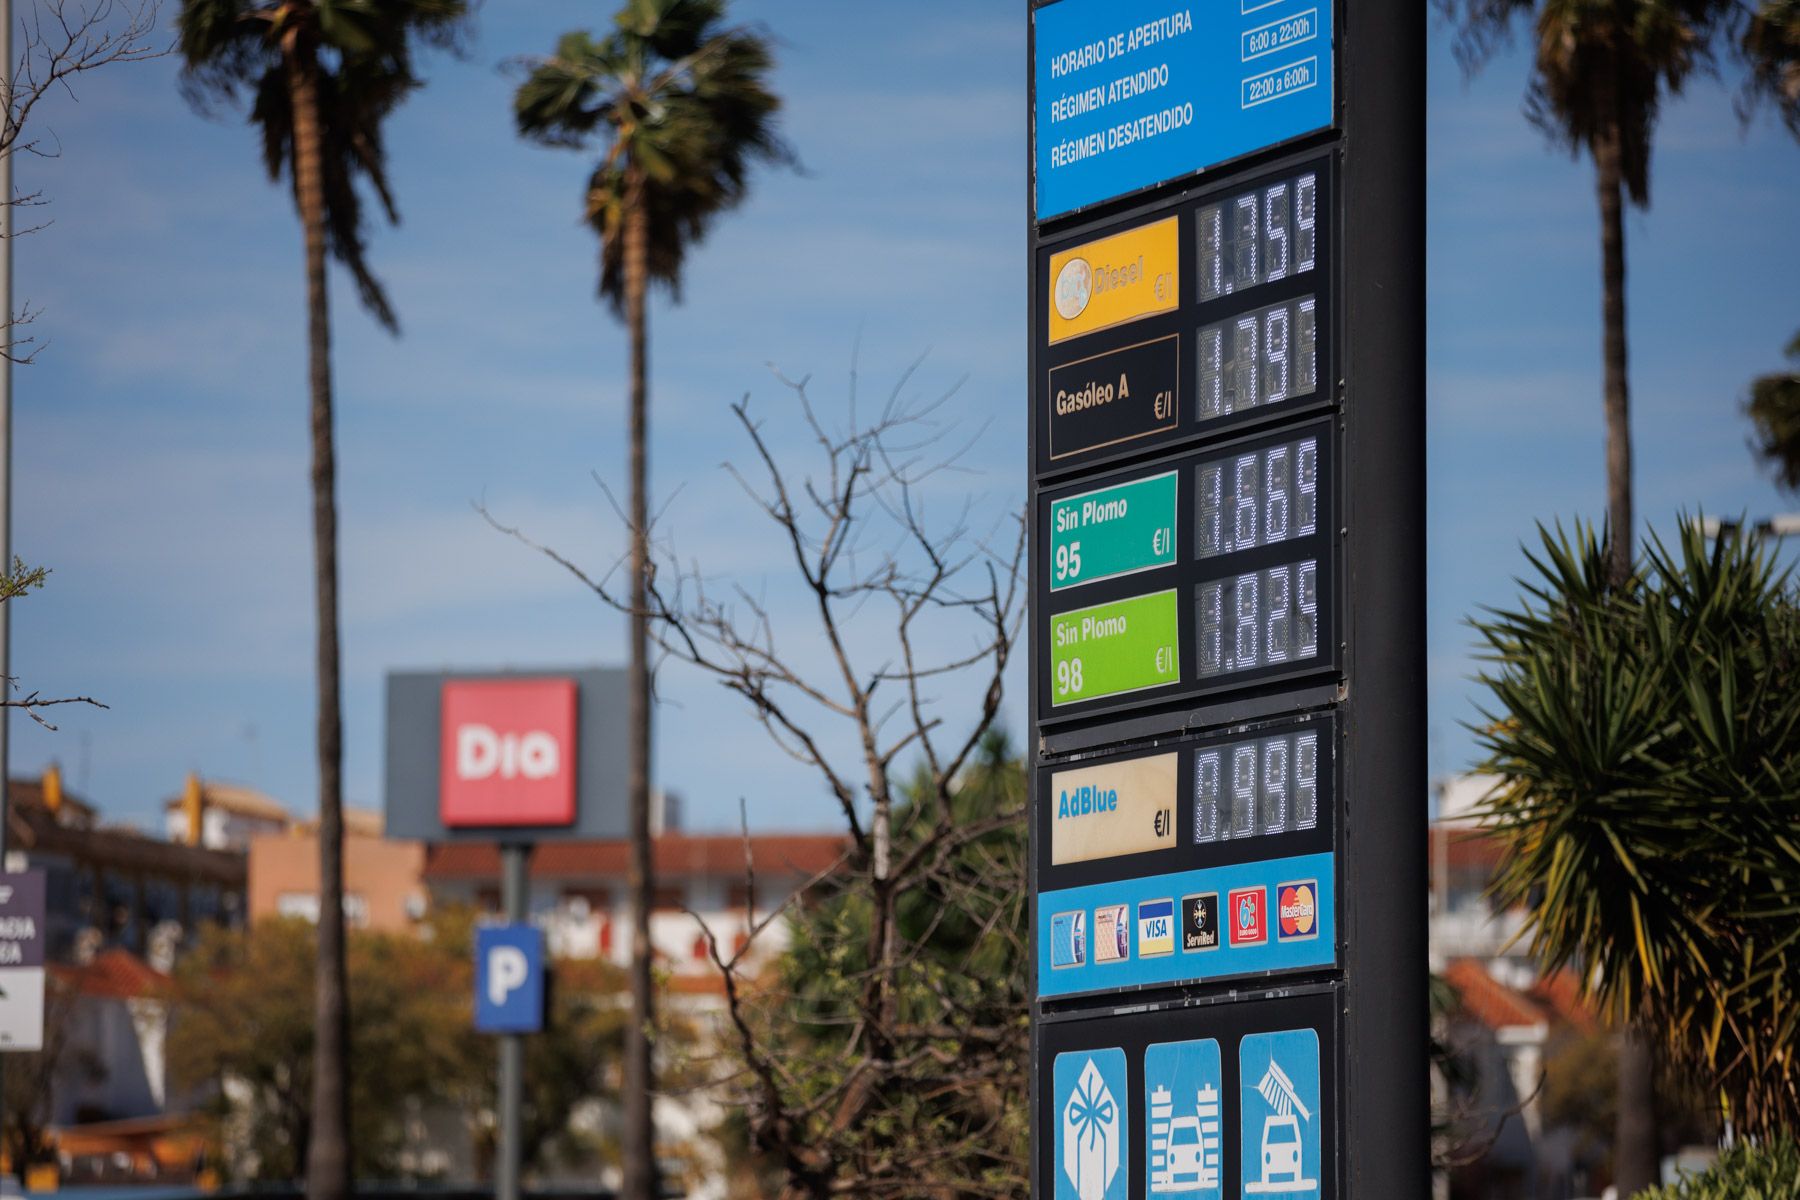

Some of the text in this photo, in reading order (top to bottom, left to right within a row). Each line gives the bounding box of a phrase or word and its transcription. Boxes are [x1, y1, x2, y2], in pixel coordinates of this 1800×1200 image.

[1051, 9, 1193, 79] HORARIO DE APERTURA
[1249, 18, 1310, 53] 6:00 a 22:00h
[1051, 63, 1169, 124] RÉGIMEN ATENDIDO
[1249, 66, 1310, 101] 22:00 a 6:00h
[1051, 102, 1193, 169] RÉGIMEN DESATENDIDO
[1213, 173, 1316, 295] 1.759
[1094, 254, 1144, 295] Diesel
[1213, 298, 1317, 416] 1.797
[1056, 373, 1130, 416] Gasóleo A
[1056, 499, 1128, 533] Sin Plomo
[1214, 439, 1317, 553] 1.669
[1056, 542, 1081, 581] 95
[1056, 615, 1127, 647] Sin Plomo
[1214, 560, 1317, 670] 1.825
[1057, 658, 1083, 696] 98
[1058, 784, 1118, 819] AdBlue
[1196, 734, 1317, 843] 0.999
[1145, 919, 1168, 939] VISA
[1280, 902, 1313, 919] MasterCard
[1187, 930, 1215, 948] ServiRed
[487, 945, 528, 1007] P
